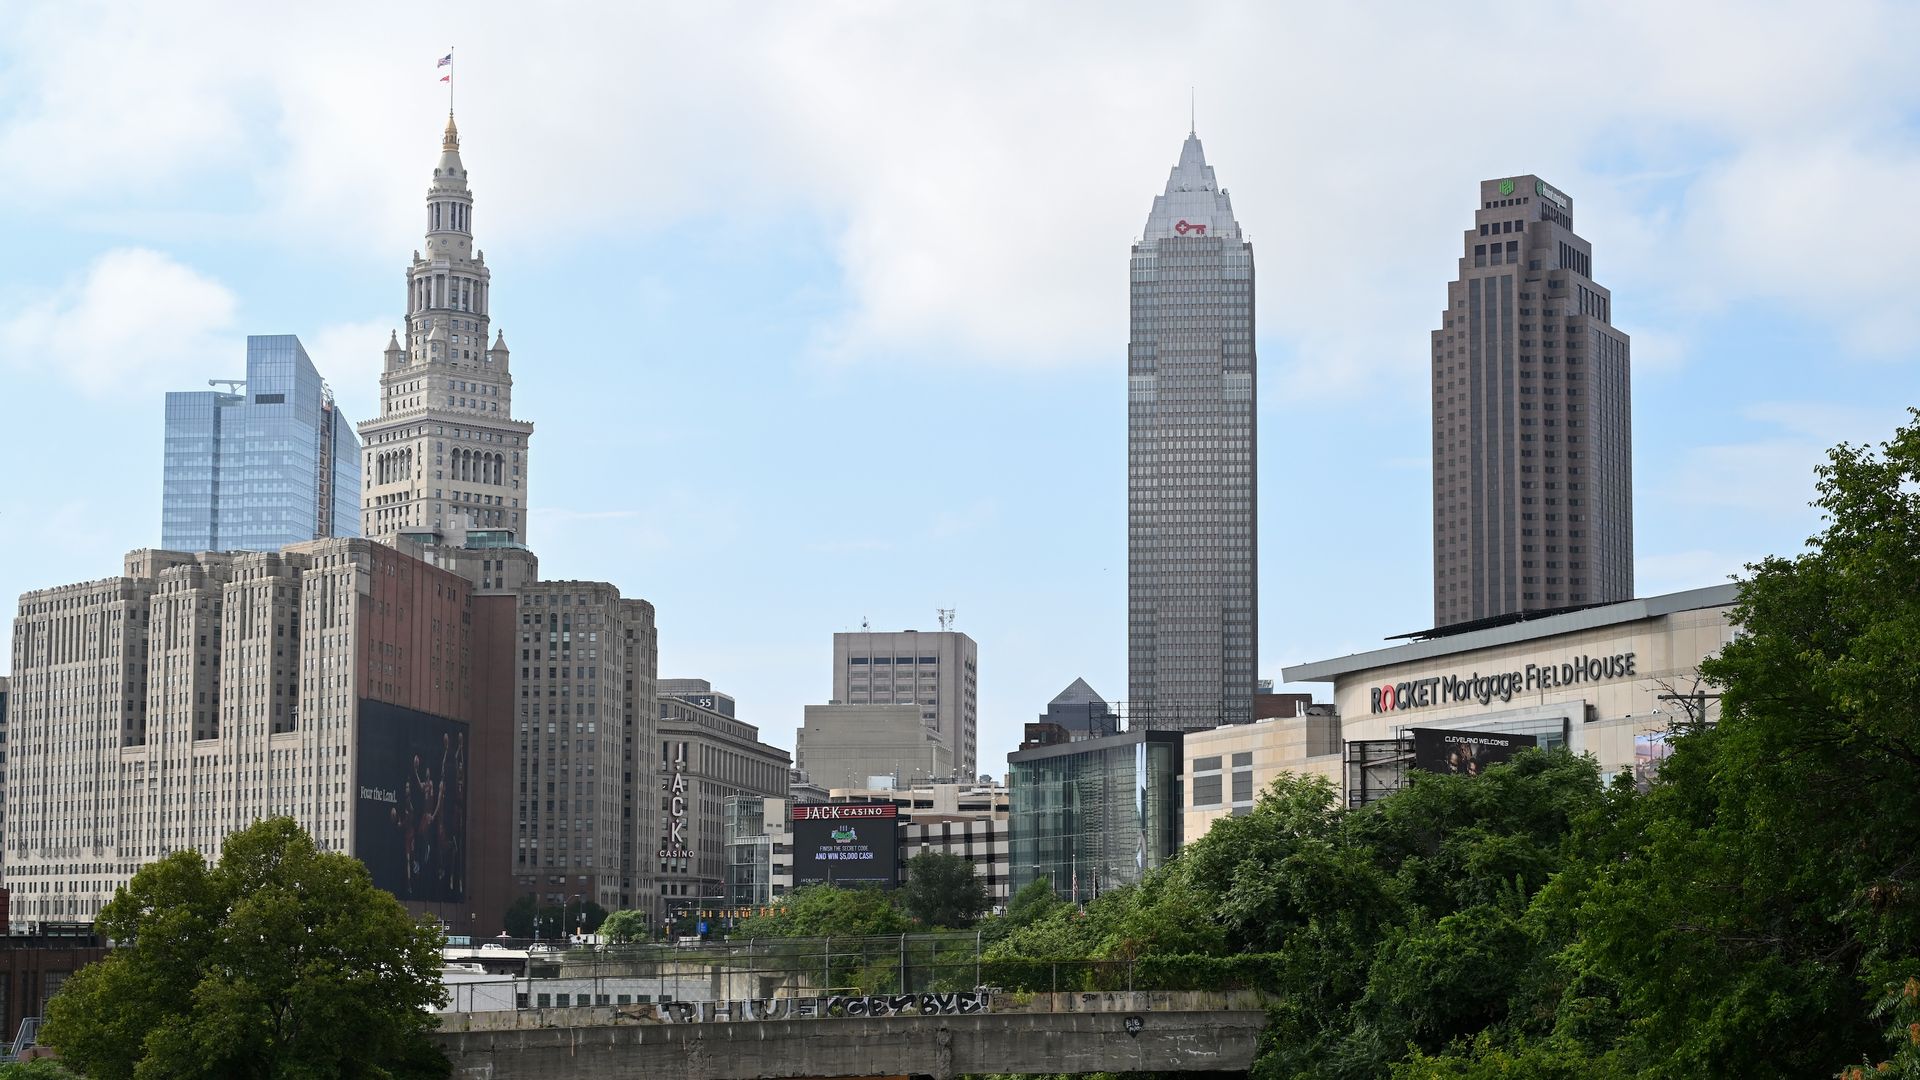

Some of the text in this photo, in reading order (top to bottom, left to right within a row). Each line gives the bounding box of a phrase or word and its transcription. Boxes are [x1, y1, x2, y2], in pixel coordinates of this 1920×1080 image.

[1371, 677, 1440, 714] ROCKET
[1441, 671, 1523, 705] Mortgage
[700, 698, 711, 707] 55
[1444, 735, 1509, 747] CLEVELAND WELCOMES
[843, 807, 883, 816] CASINO
[659, 850, 695, 858] CASINO
[815, 852, 874, 861] AND WIN $5,000 CASH
